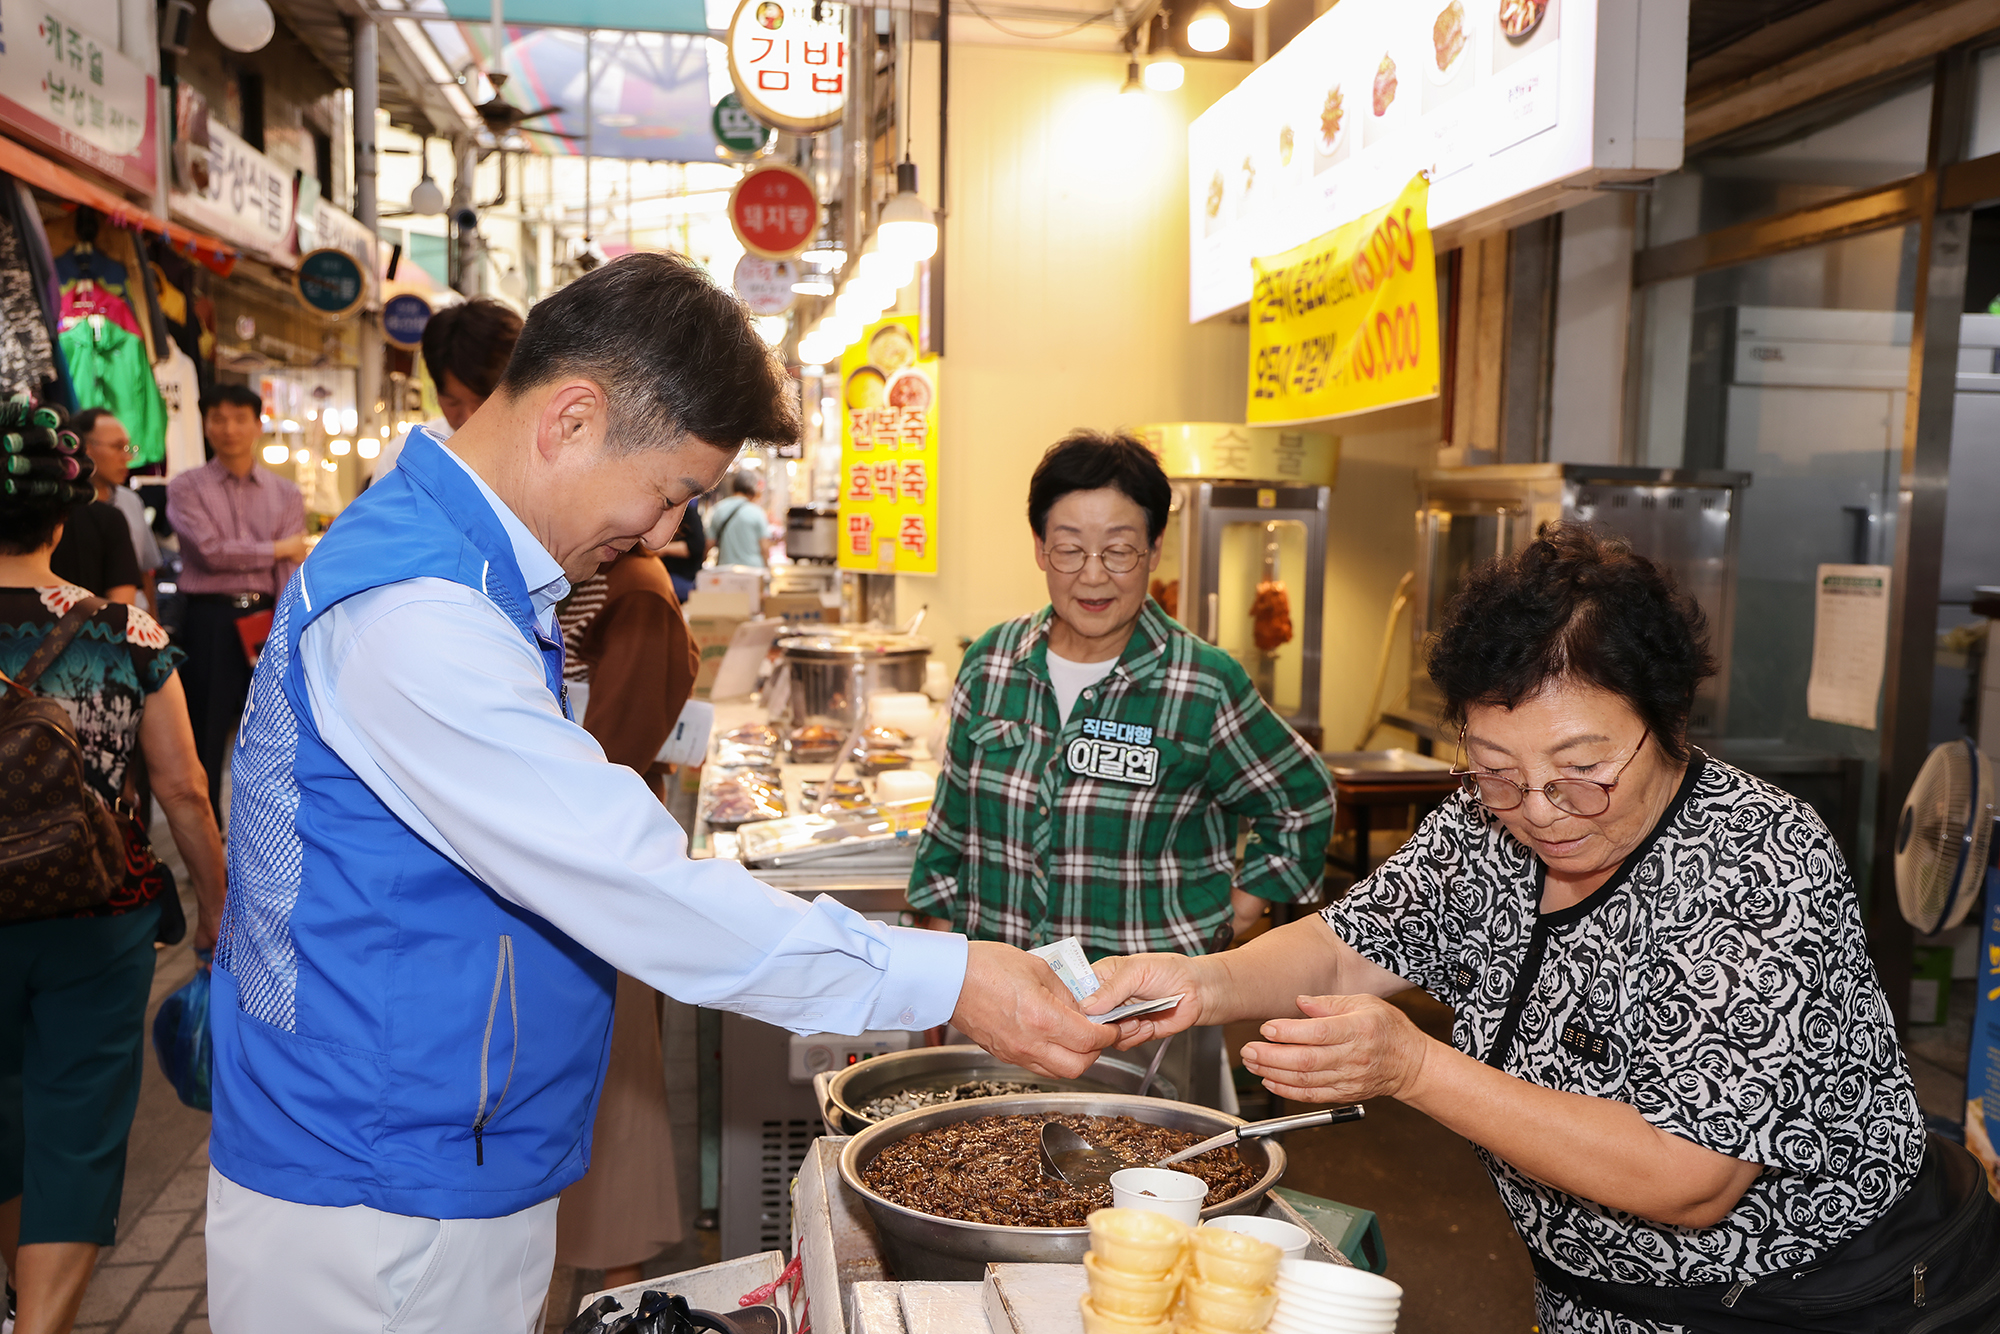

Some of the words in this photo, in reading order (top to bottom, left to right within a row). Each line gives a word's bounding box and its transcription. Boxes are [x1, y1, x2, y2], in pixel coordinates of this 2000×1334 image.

[750, 38, 848, 93] 김밥
[1352, 302, 1421, 382] 10,000
[850, 407, 927, 450] 전복죽
[850, 461, 926, 503] 호박죽
[1082, 717, 1153, 746] 직무대행
[1068, 738, 1157, 784] 이길연
